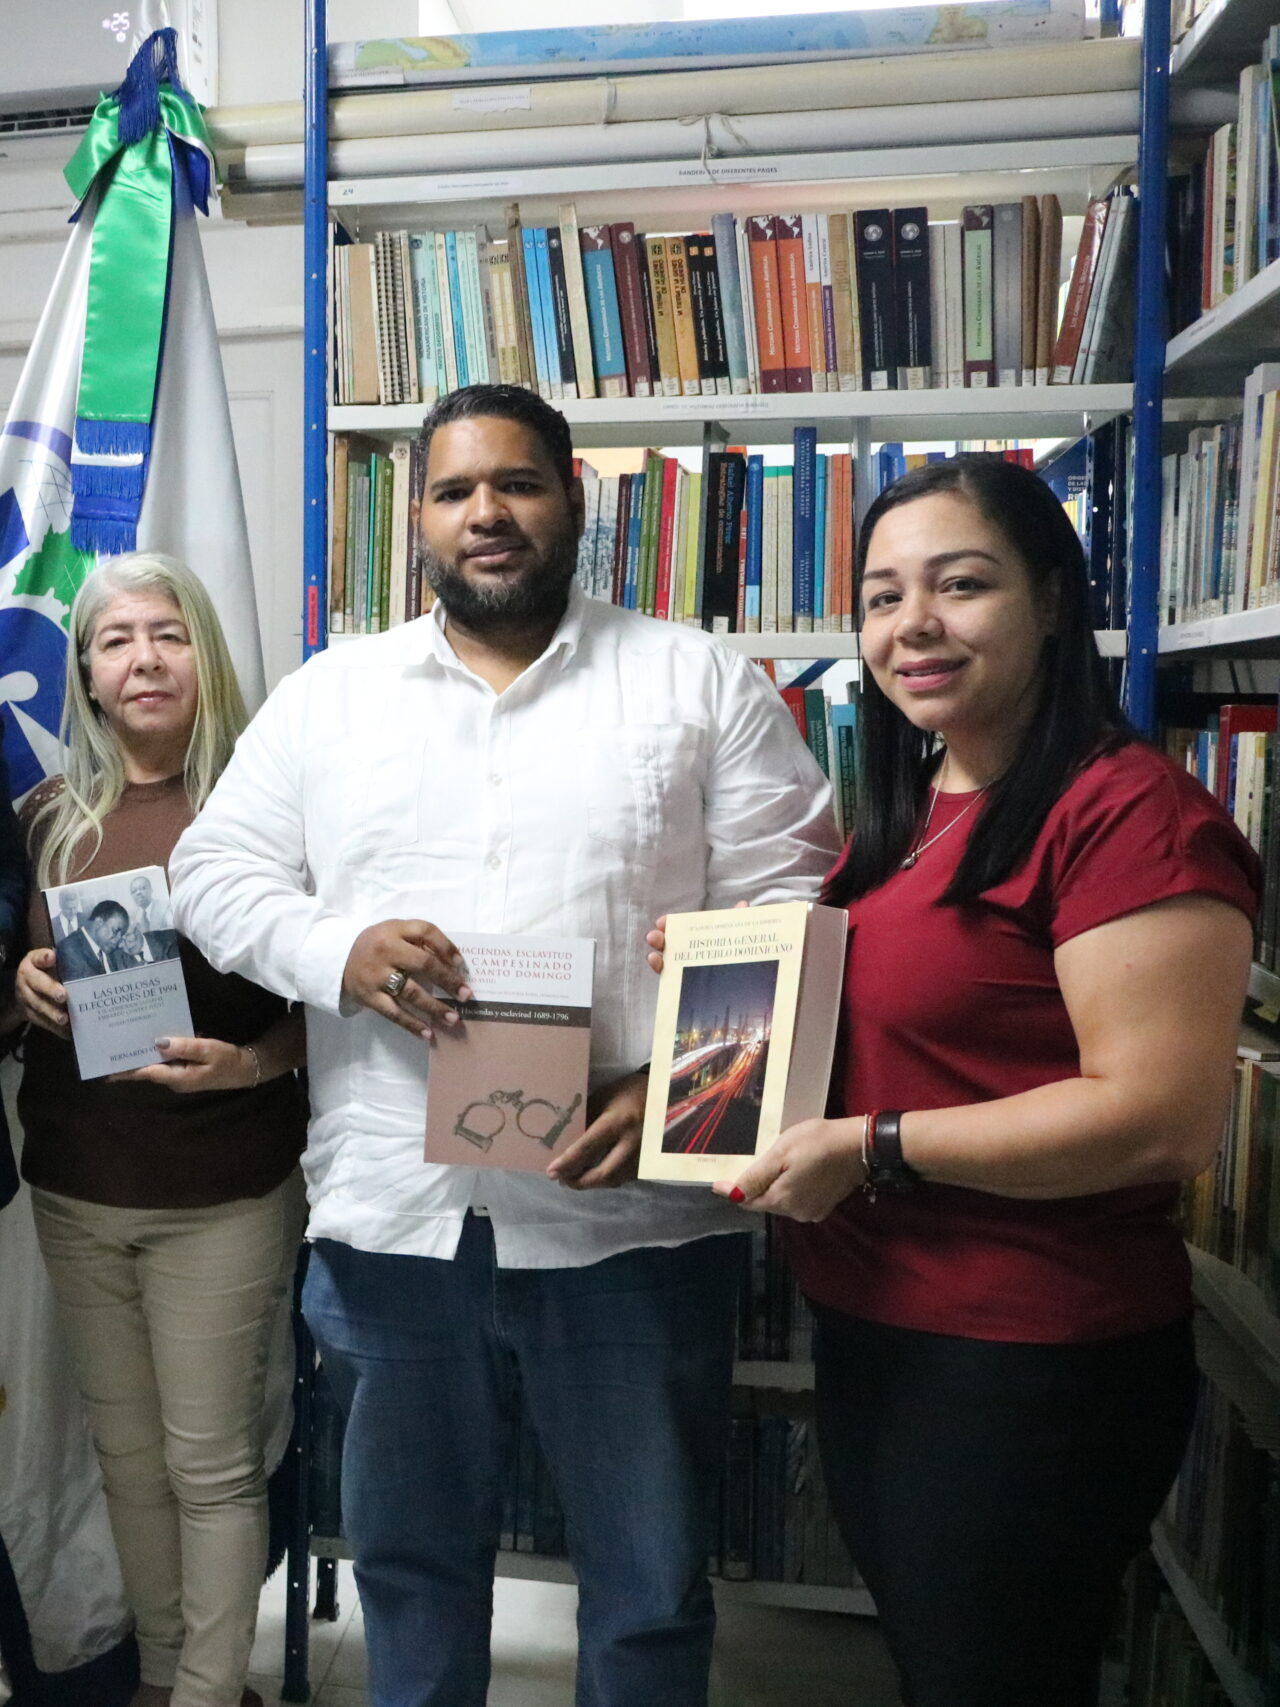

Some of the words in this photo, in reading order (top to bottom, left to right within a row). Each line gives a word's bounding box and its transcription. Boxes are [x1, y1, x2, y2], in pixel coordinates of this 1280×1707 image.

[423, 313, 431, 359] PANAMERICANO
[718, 508, 725, 519] de
[726, 491, 734, 519] Alberto
[689, 936, 733, 950] HISTORIA
[733, 932, 779, 947] GENERAL
[516, 950, 572, 960] ESCLAVITUD
[674, 951, 694, 961] DEL
[695, 948, 733, 961] PUEBLO
[733, 943, 793, 958] DOMINICANO
[471, 957, 572, 971] CAMPESINADO
[475, 968, 510, 978] SANTO
[515, 971, 572, 981] DOMINGO
[93, 985, 112, 999] LAS
[114, 977, 161, 995] DOLOSAS
[78, 991, 141, 1013] ELECCIONES
[143, 989, 157, 1000] DE
[500, 1010, 532, 1020] esclavitud
[533, 1011, 569, 1021] 1689-1796
